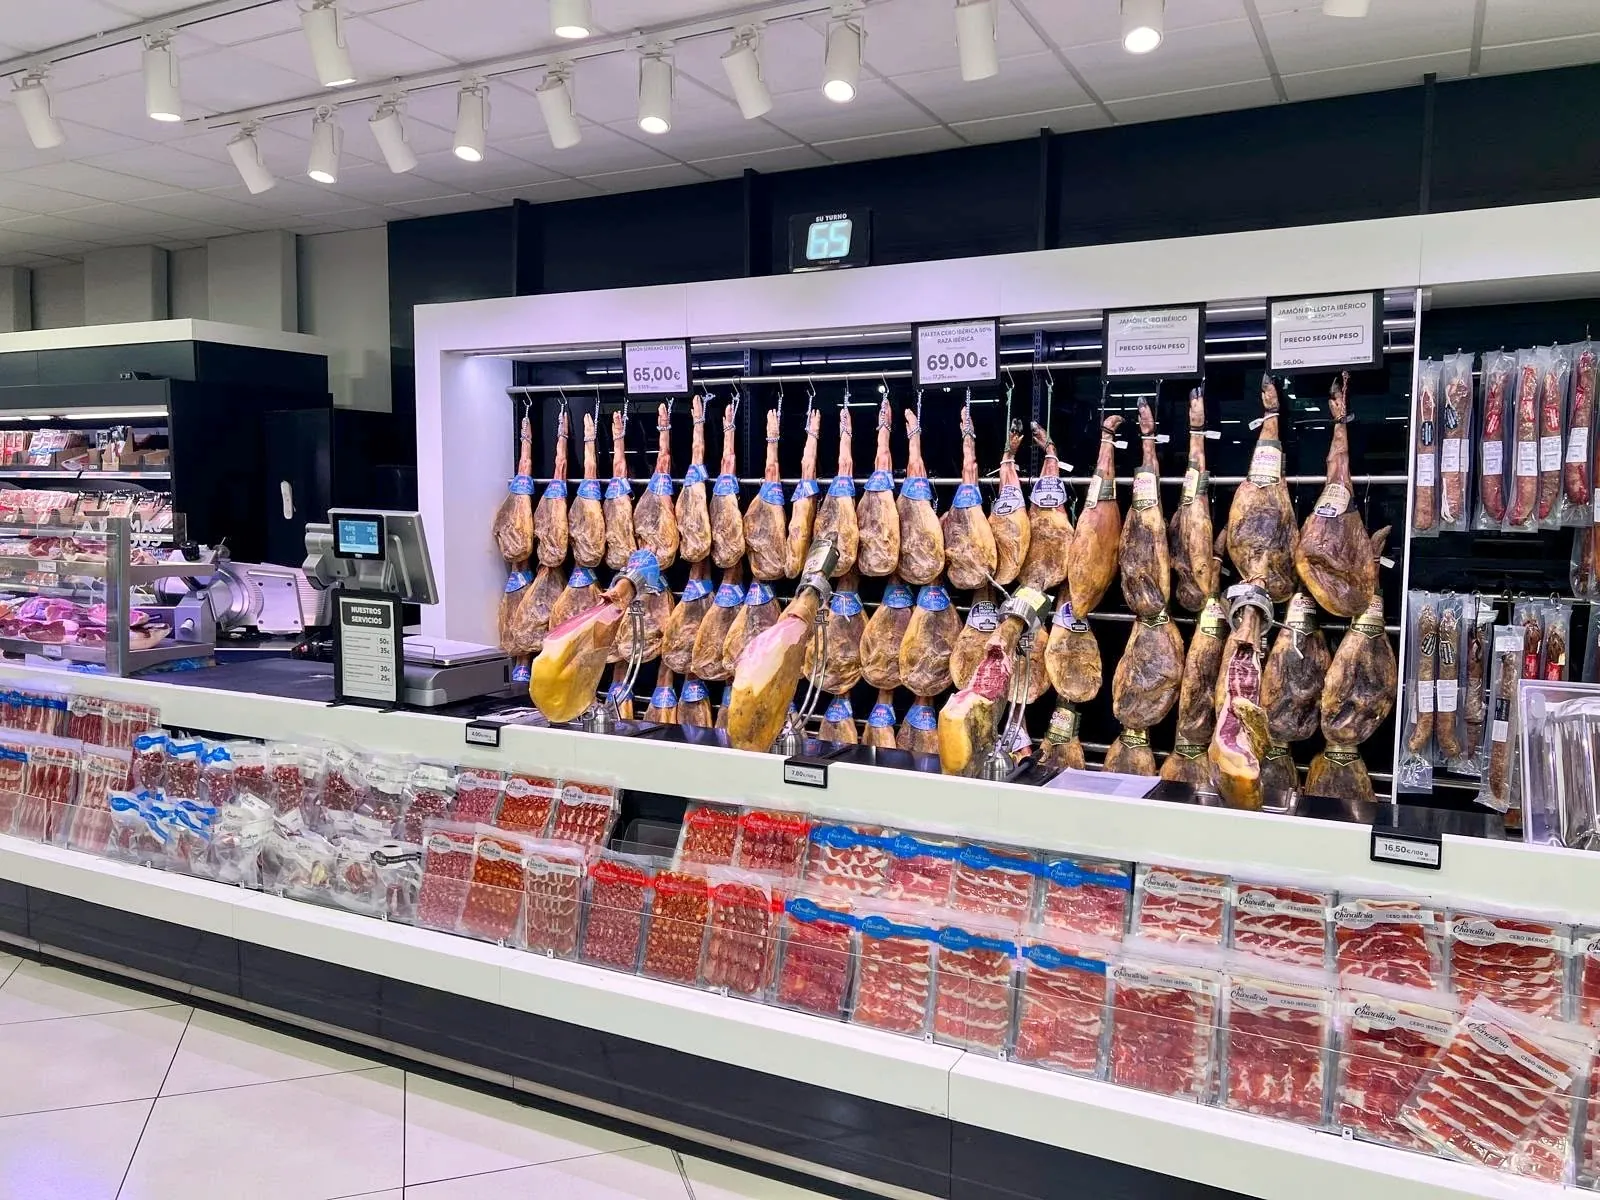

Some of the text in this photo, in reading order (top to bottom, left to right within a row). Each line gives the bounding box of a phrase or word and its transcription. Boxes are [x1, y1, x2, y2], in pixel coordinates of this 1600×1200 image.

[825, 213, 847, 221] TURNO
[808, 220, 850, 259] 65
[1337, 302, 1366, 310] IBÉRICO
[937, 336, 952, 344] RAZA
[1312, 333, 1338, 341] SEGÚN
[927, 352, 988, 371] 69,00€
[633, 366, 681, 383] 65,00€
[350, 606, 381, 615] NUESTROS
[351, 616, 382, 625] SERVICIOS
